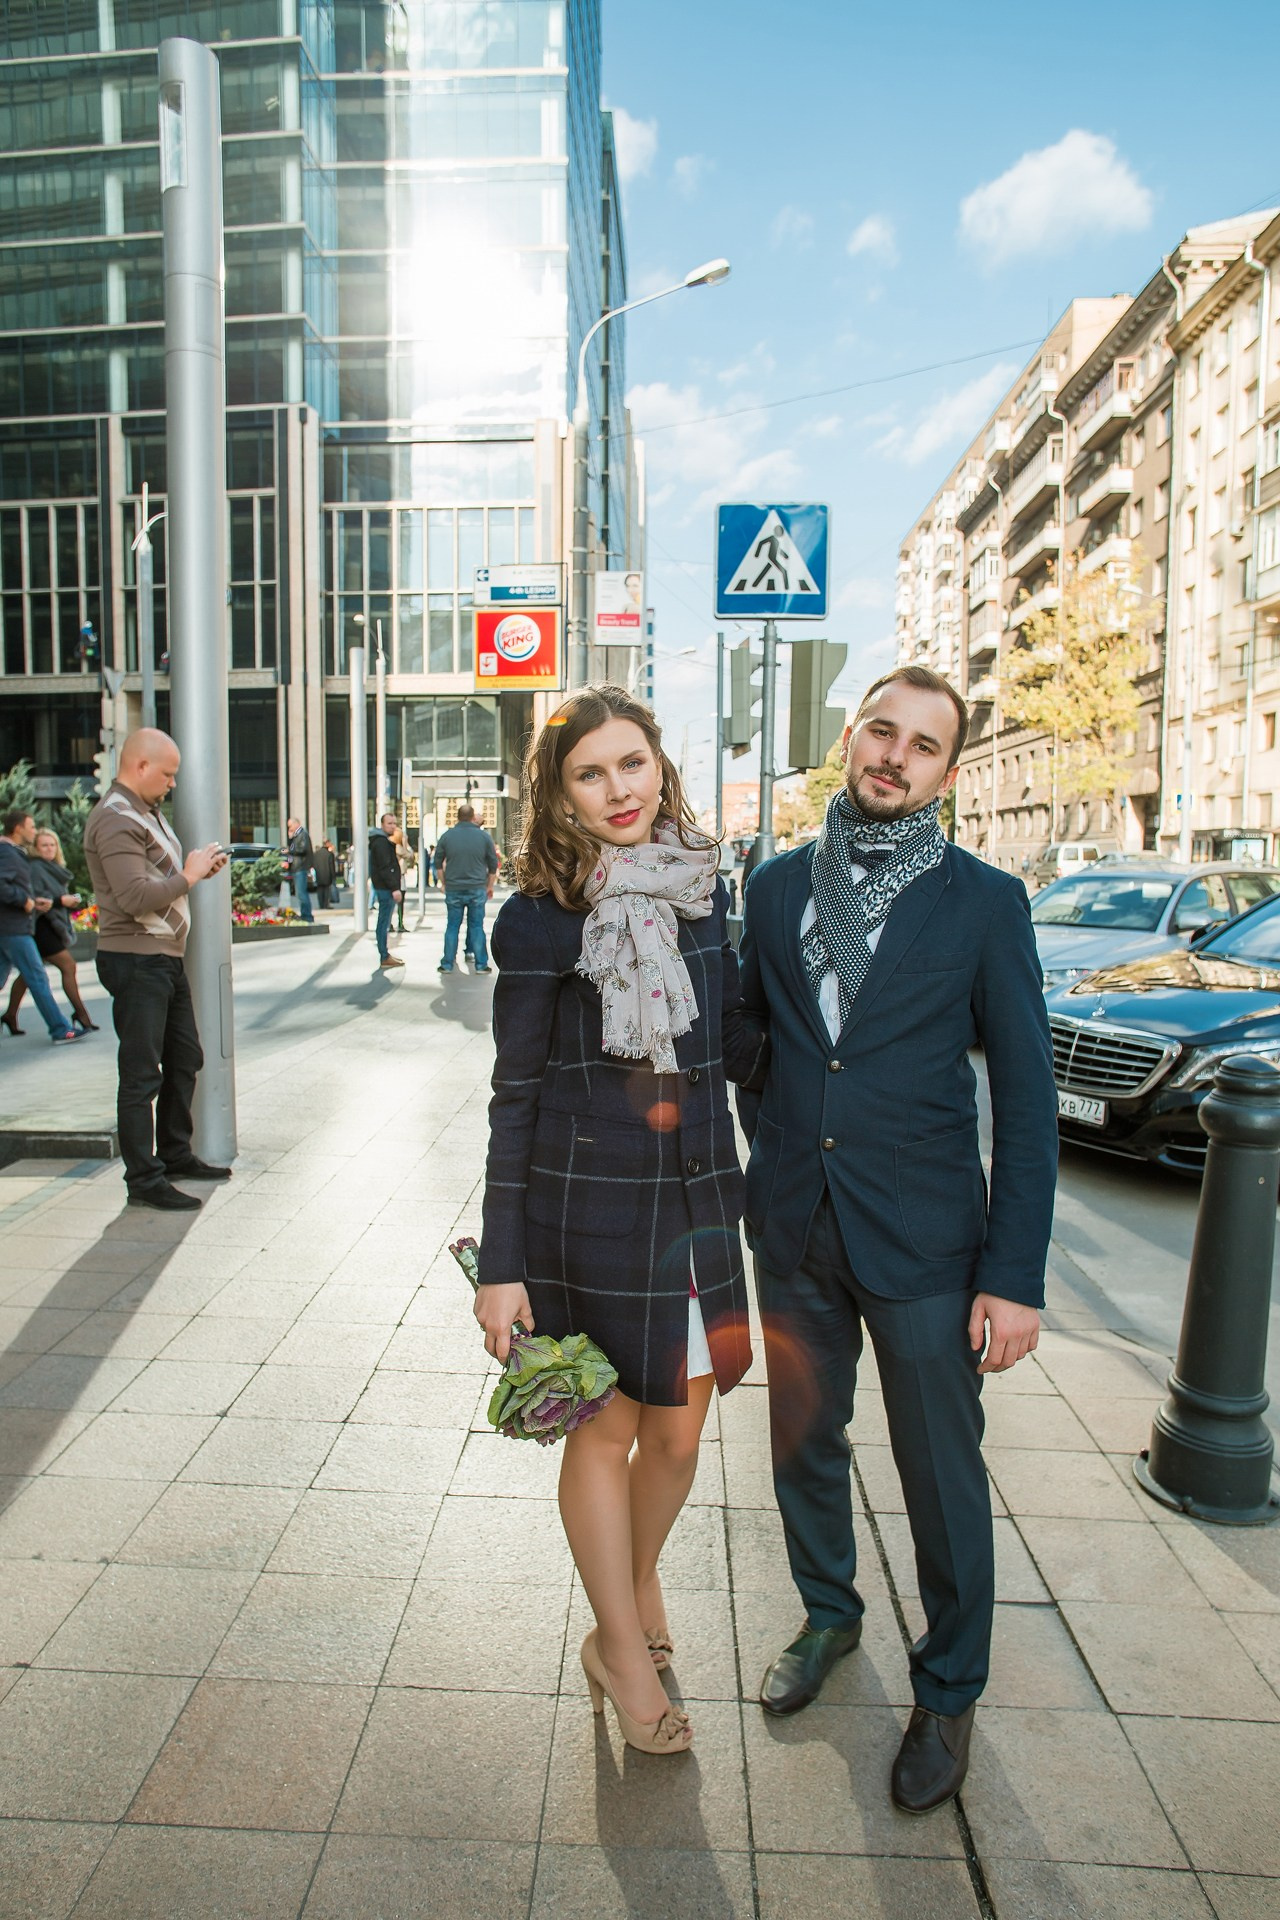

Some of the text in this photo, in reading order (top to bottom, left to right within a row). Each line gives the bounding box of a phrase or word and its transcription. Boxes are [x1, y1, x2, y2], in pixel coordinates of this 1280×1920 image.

[501, 625, 533, 640] BURGER
[502, 632, 534, 650] KING
[1080, 1099, 1100, 1115] 777
